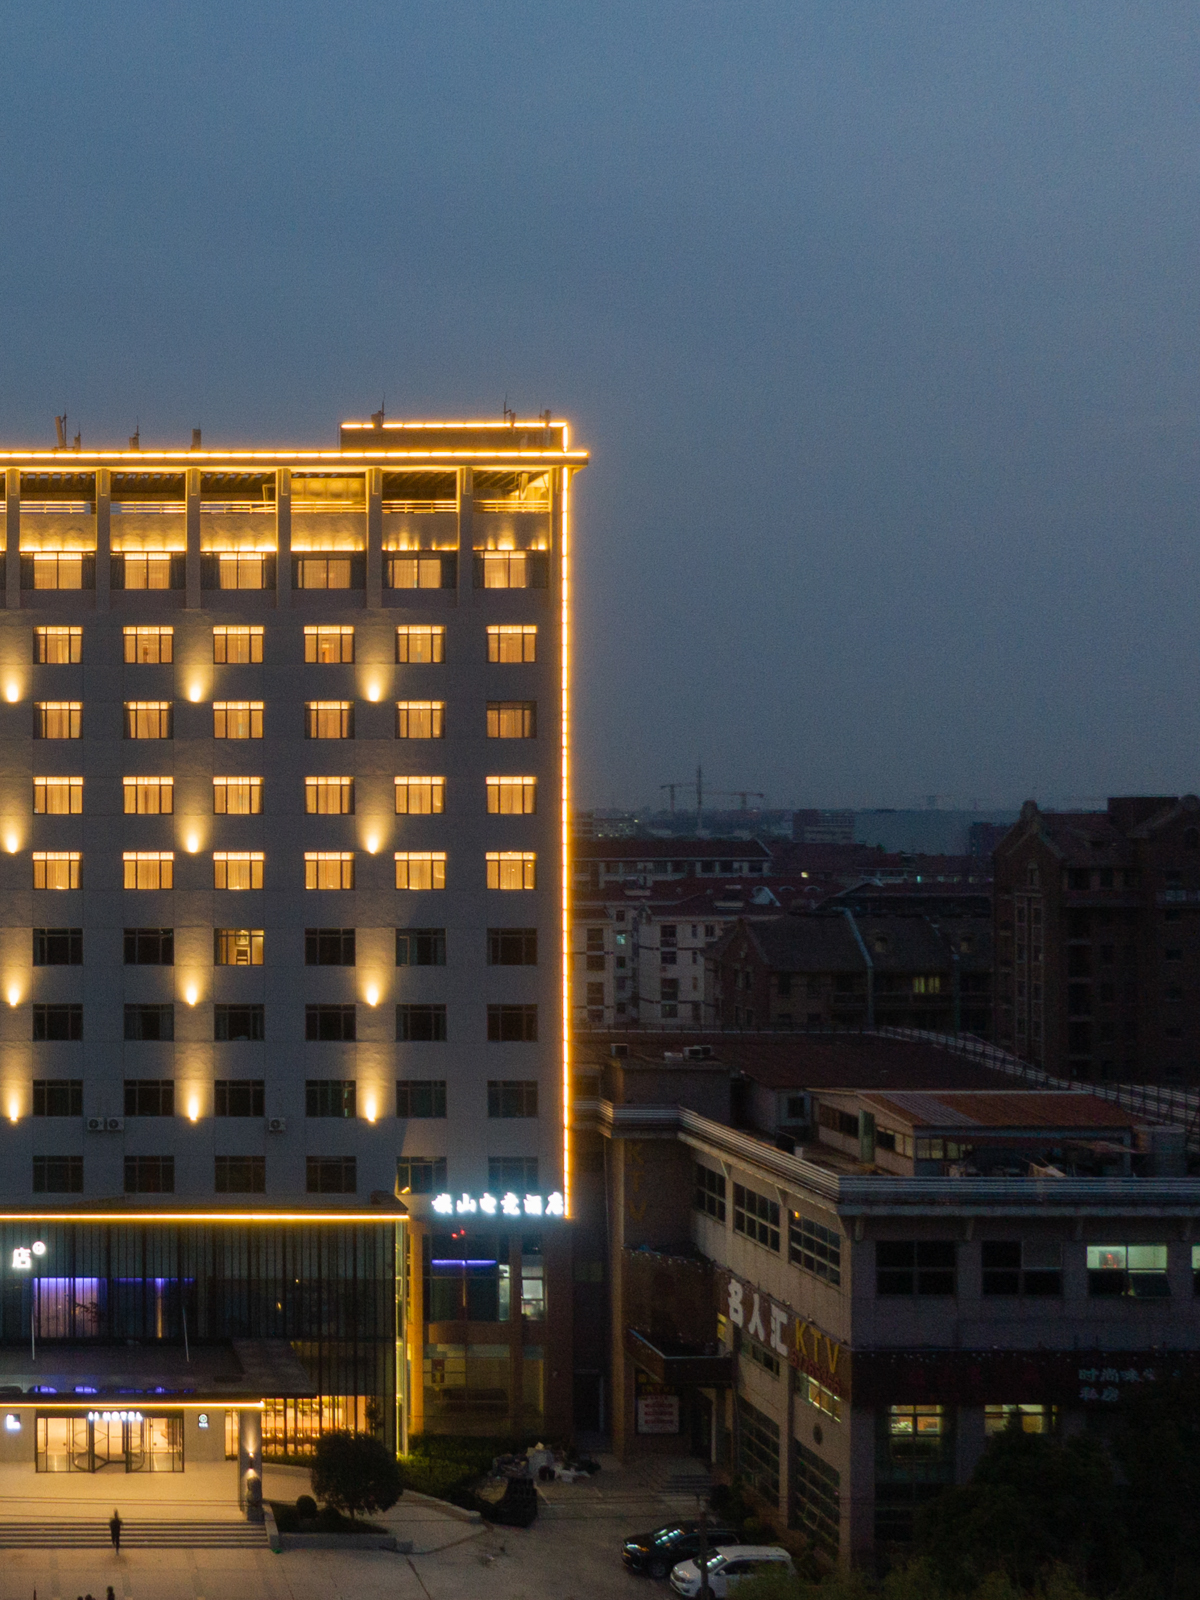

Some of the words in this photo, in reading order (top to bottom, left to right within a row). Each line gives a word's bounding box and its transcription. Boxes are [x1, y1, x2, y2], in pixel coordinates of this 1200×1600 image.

[727, 1278, 788, 1357] 名人汇
[794, 1317, 840, 1374] KTV
[102, 1411, 143, 1422] HOTEL
